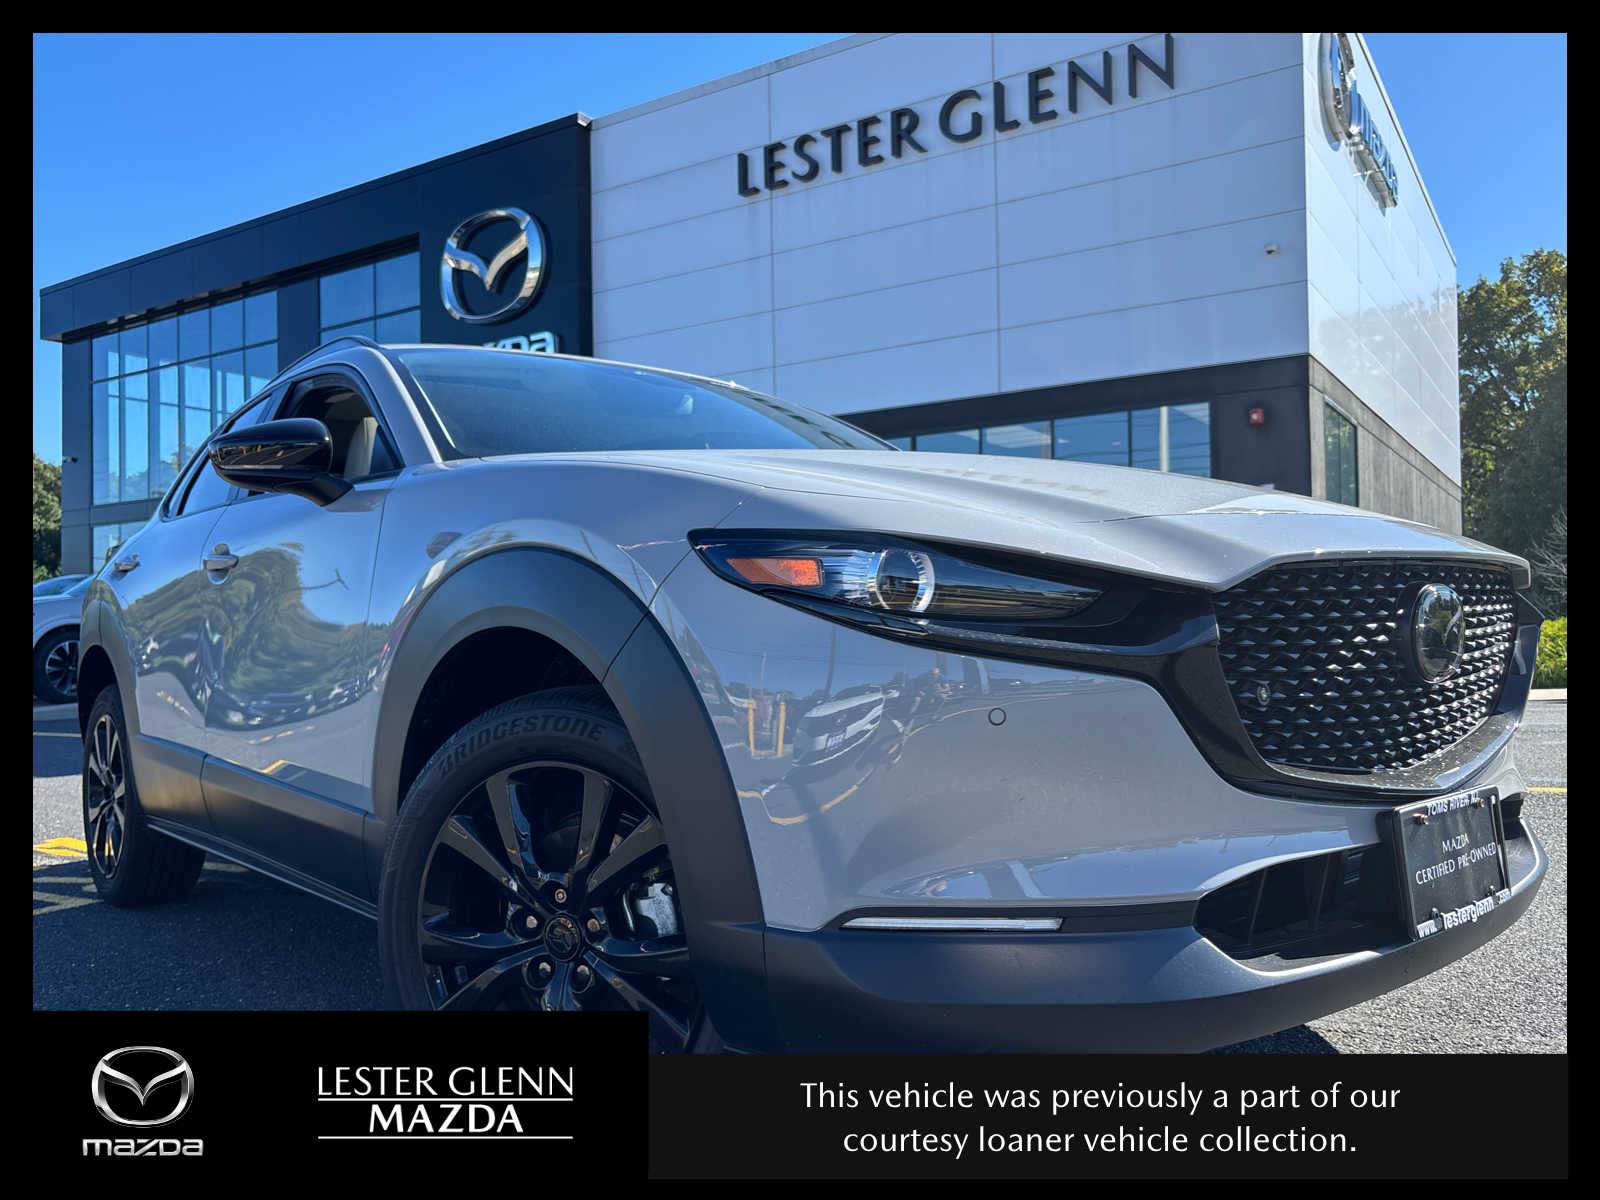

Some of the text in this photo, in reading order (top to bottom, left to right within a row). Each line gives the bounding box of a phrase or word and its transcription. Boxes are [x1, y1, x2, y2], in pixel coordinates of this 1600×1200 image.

[738, 33, 1175, 198] LESTER GLENN
[439, 714, 608, 778] BRIDGESTONE
[1415, 841, 1497, 885] CERTIFIED PRE-OWNED
[1442, 832, 1469, 854] MAZDA
